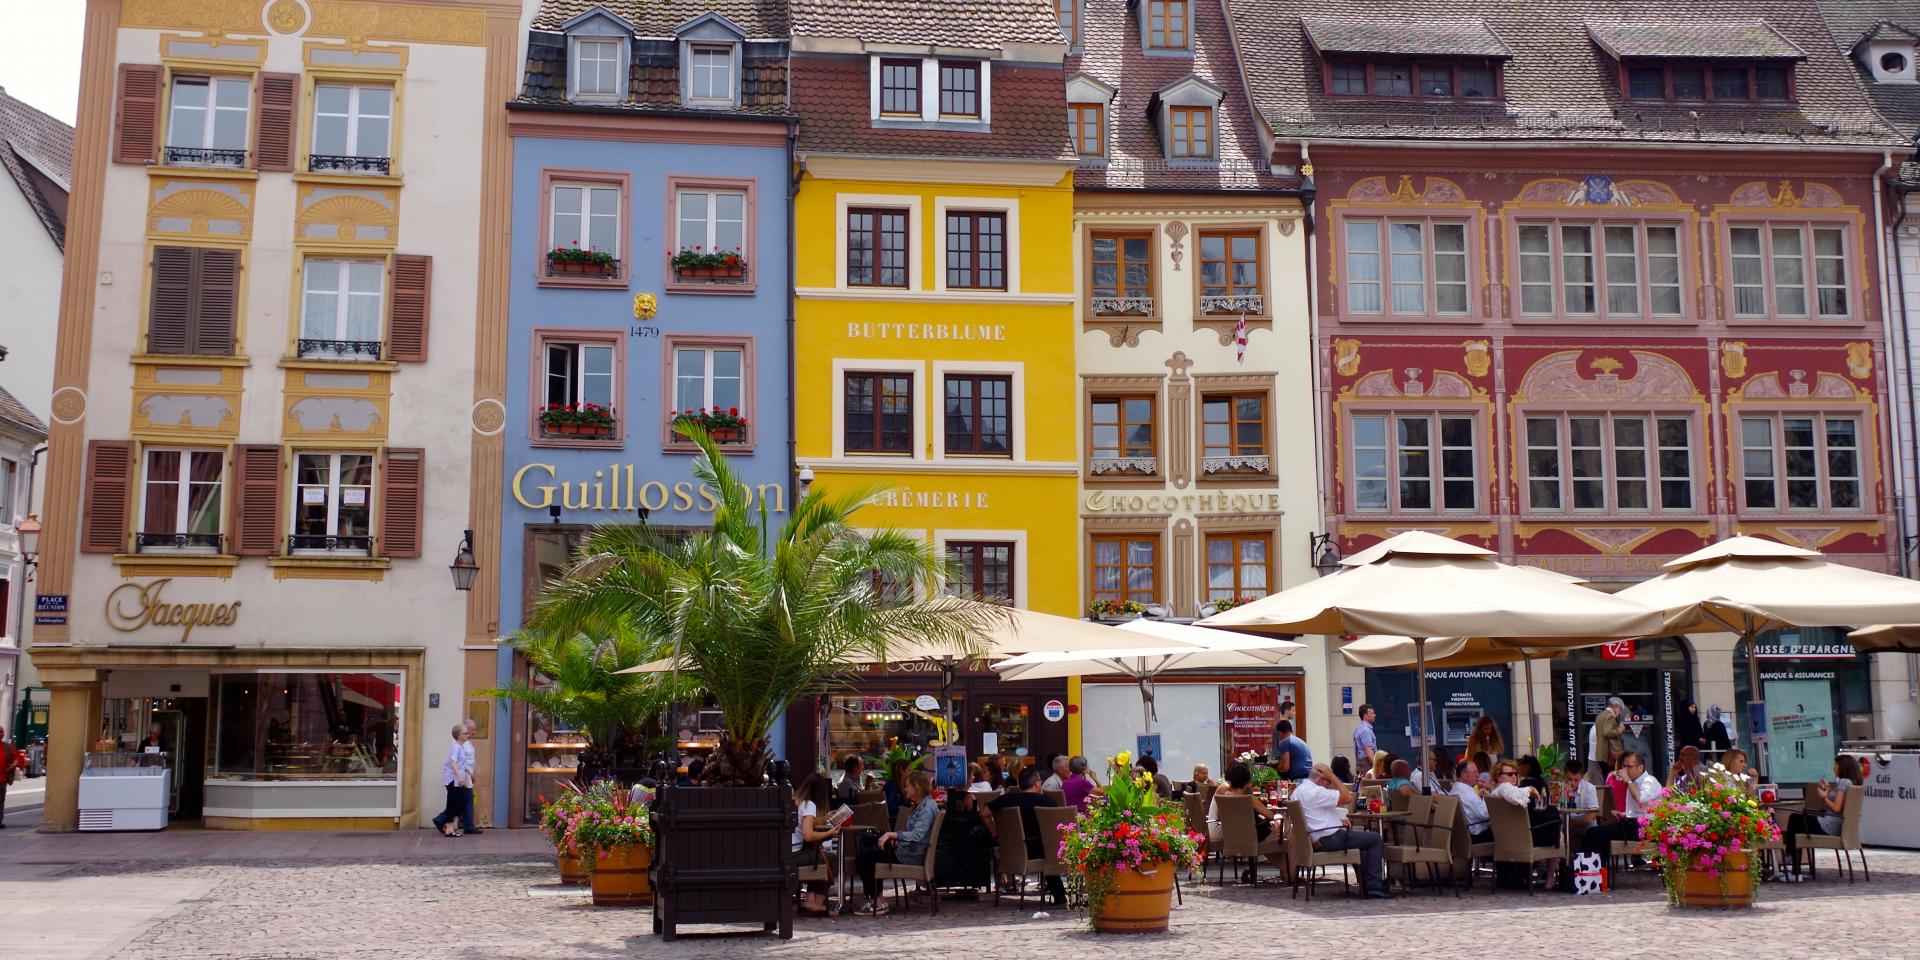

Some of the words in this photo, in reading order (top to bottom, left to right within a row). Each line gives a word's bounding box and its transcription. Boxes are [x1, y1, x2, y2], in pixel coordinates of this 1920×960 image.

[630, 326, 660, 337] 1479
[847, 322, 1006, 341] BUTTERBLUME
[872, 486, 989, 508] CRÊMERIE
[1086, 490, 1280, 513] CHOCOTHÈQUE
[104, 577, 242, 643] Jacques
[1746, 645, 1785, 654] AISSE
[1417, 671, 1447, 679] ANQUE
[1448, 671, 1503, 679] AUTOMATIQUE
[1566, 672, 1575, 726] PARTICULIERS
[1664, 671, 1675, 733] PROFESSIONNELS
[1567, 728, 1577, 746] AUX
[1666, 733, 1675, 751] AUX
[1898, 786, 1917, 799] Tell
